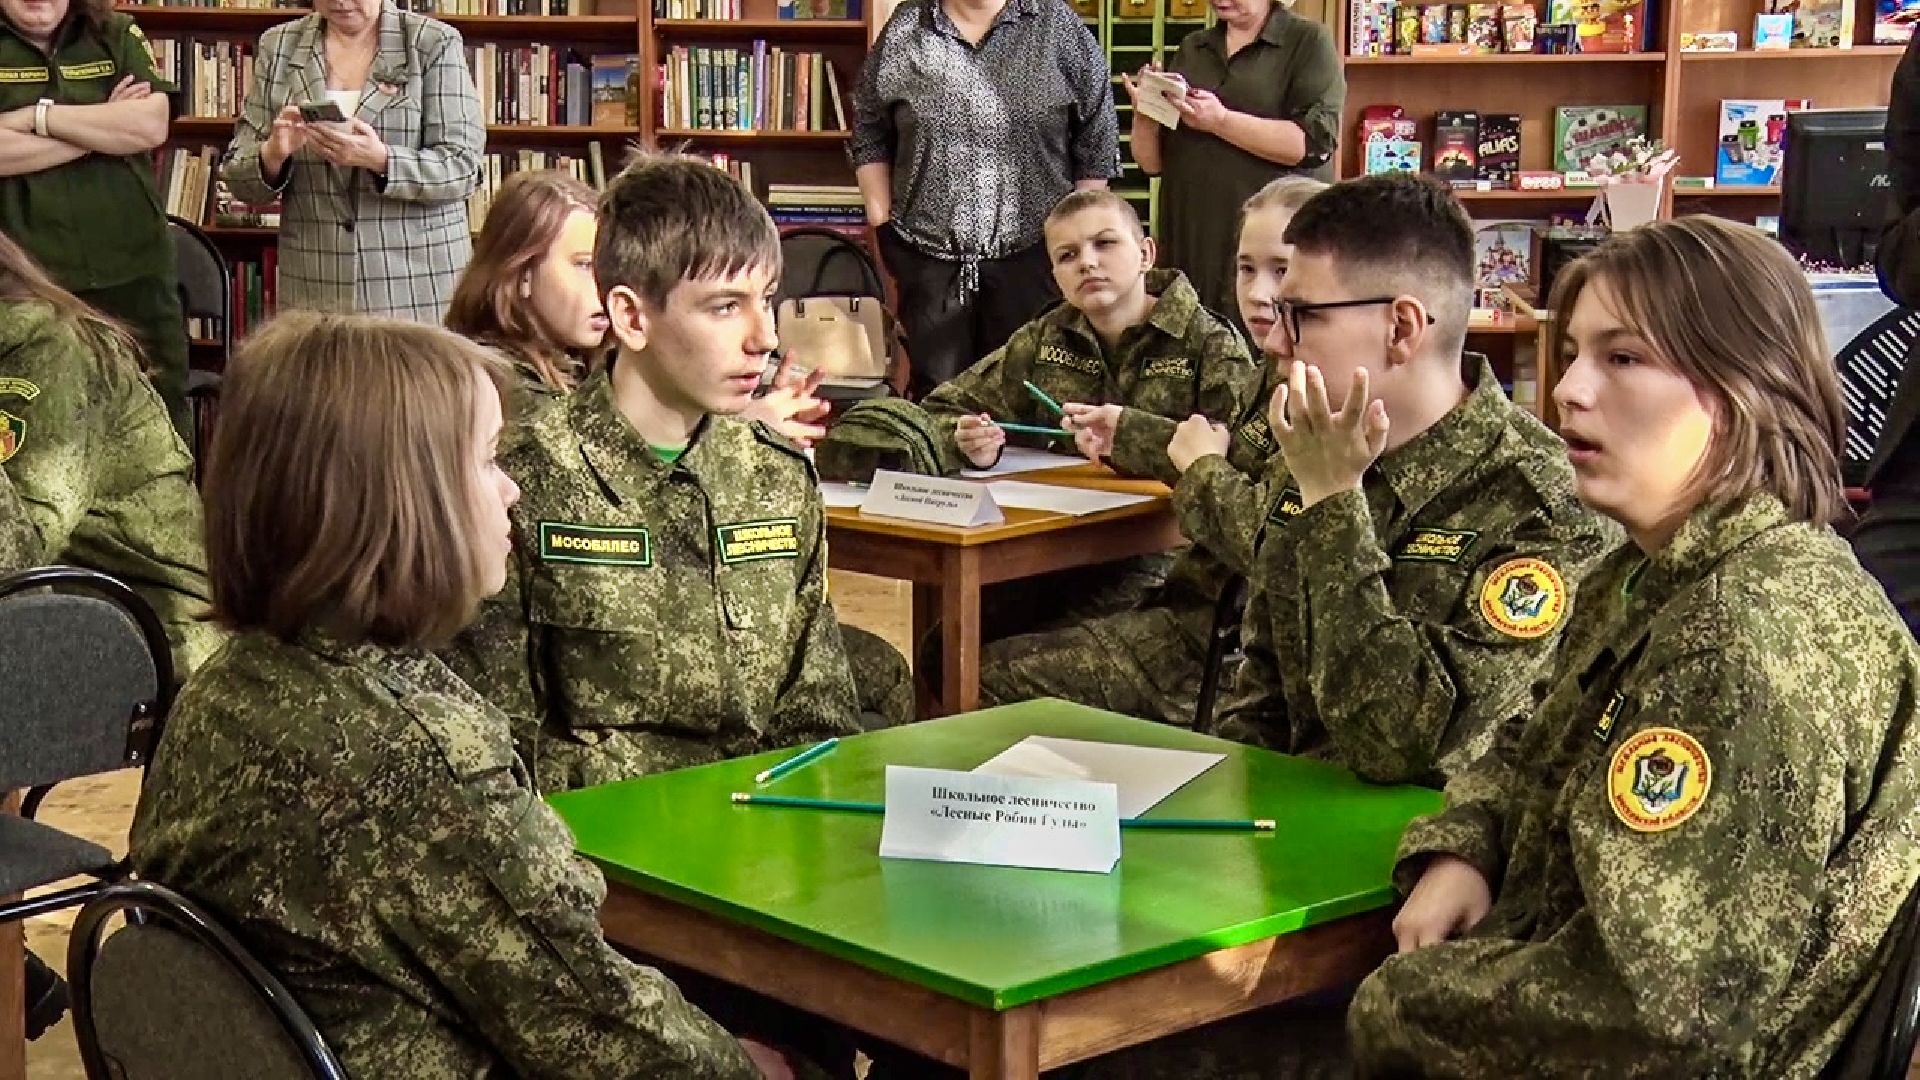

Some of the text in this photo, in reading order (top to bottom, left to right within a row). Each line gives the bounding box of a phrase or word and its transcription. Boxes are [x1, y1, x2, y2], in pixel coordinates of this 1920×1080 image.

[551, 534, 641, 553] МОСОБЛЛЕС
[931, 786, 1096, 811] Школьное лесничество
[930, 805, 992, 823] «Лесные
[995, 809, 1037, 825] Робин
